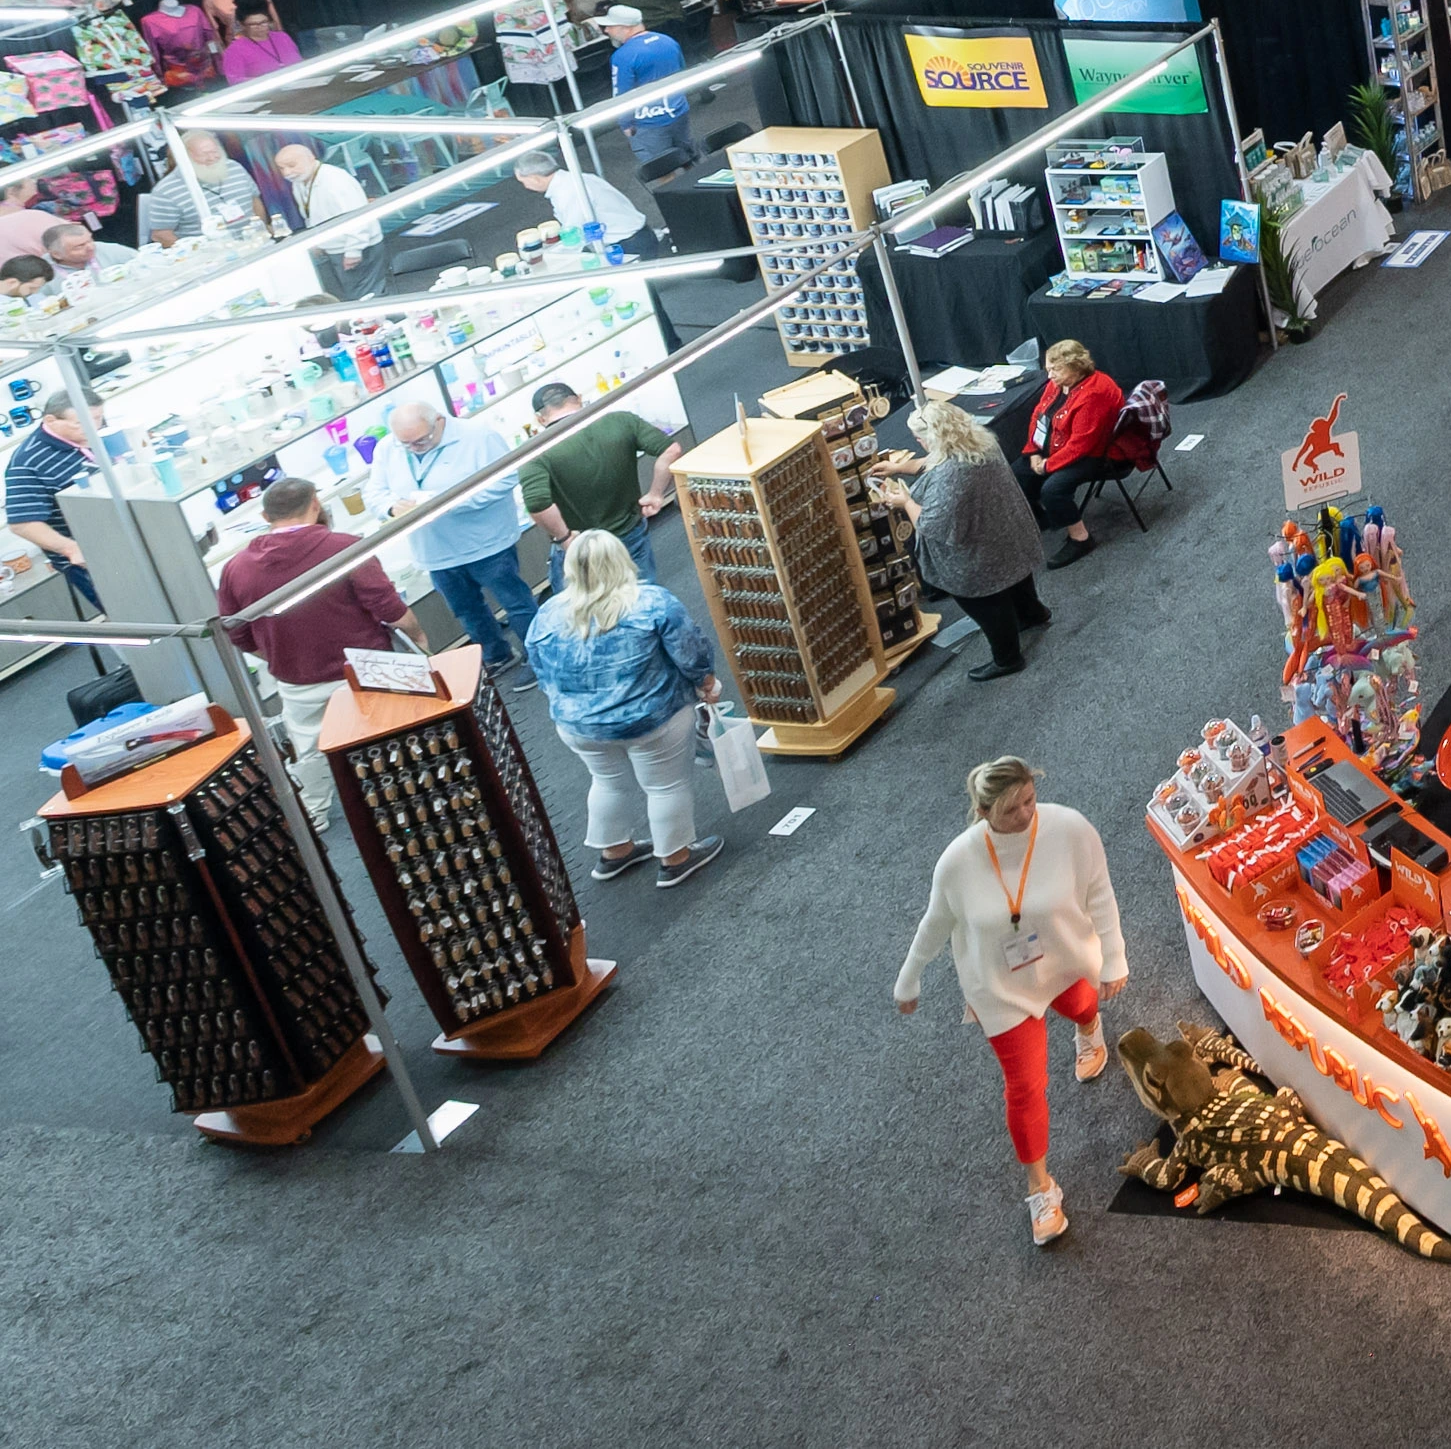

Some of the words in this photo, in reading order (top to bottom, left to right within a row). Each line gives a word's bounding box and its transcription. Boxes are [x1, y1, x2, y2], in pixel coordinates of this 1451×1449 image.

[967, 62, 1025, 71] SOUVENIR
[1078, 67, 1132, 86] Wayn
[1146, 72, 1190, 87] arver
[925, 68, 1030, 91] SOURCE
[1300, 467, 1345, 487] WILD
[1395, 861, 1424, 886] WILD
[1176, 886, 1253, 991] WILD
[1259, 986, 1404, 1130] REPUBLIC
